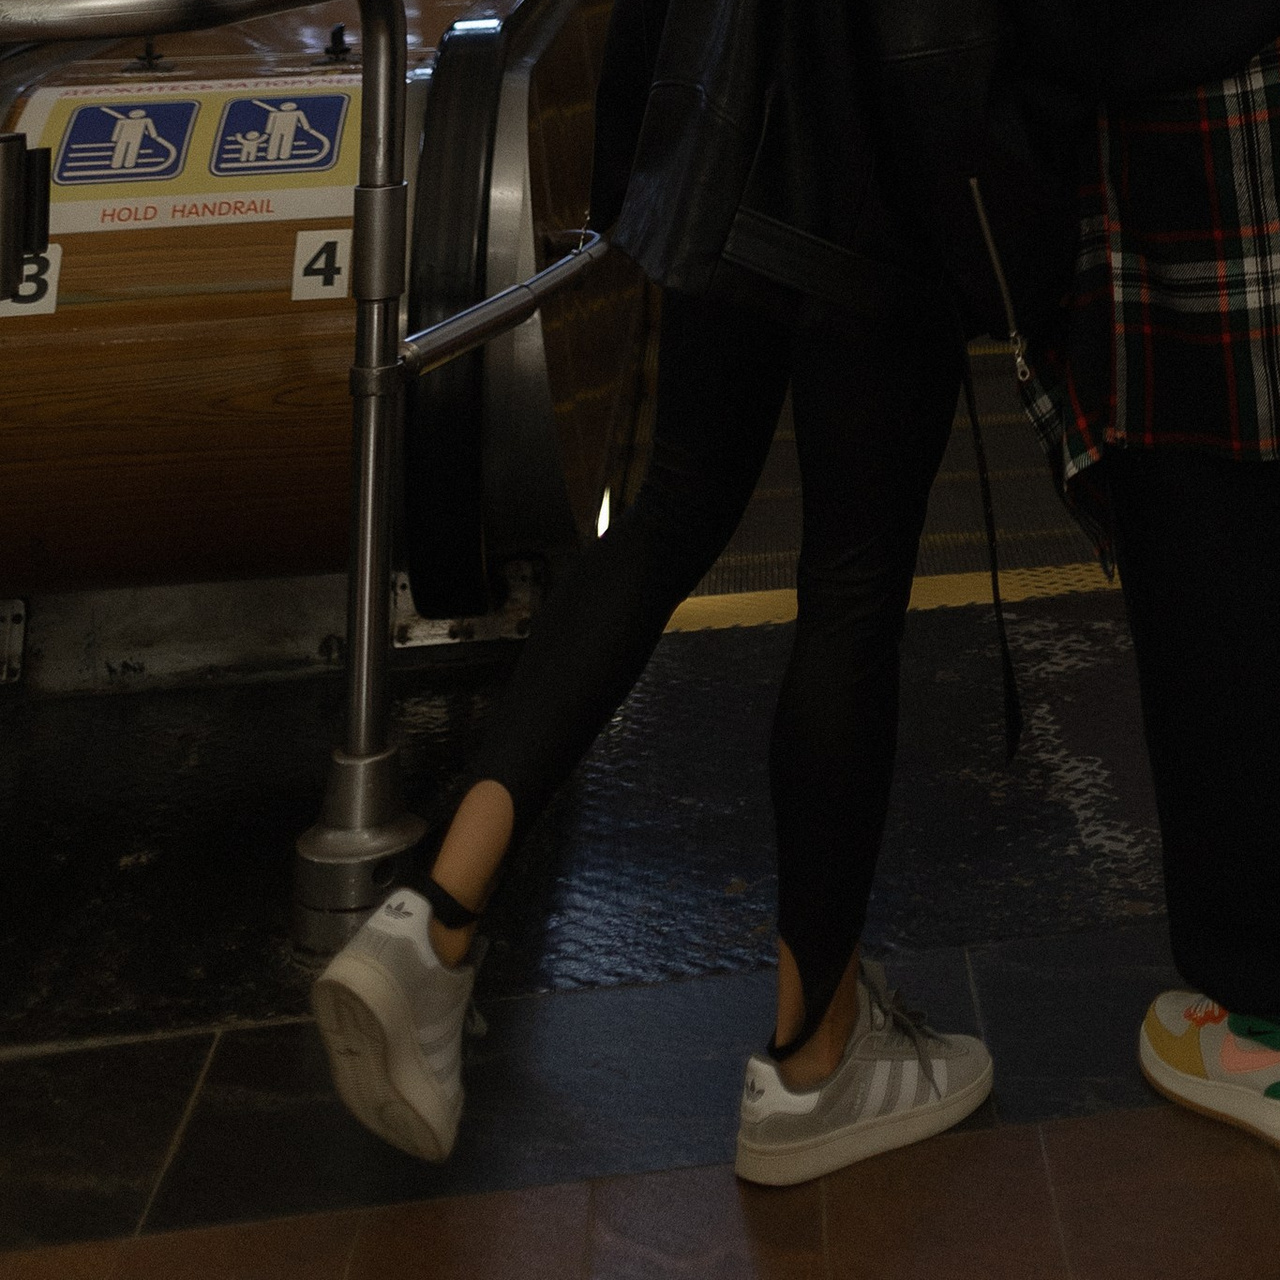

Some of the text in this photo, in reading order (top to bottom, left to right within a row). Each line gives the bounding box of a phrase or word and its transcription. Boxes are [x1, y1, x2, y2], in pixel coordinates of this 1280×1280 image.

[101, 199, 275, 223] HOLD HANDRAIL
[303, 241, 341, 286] 4
